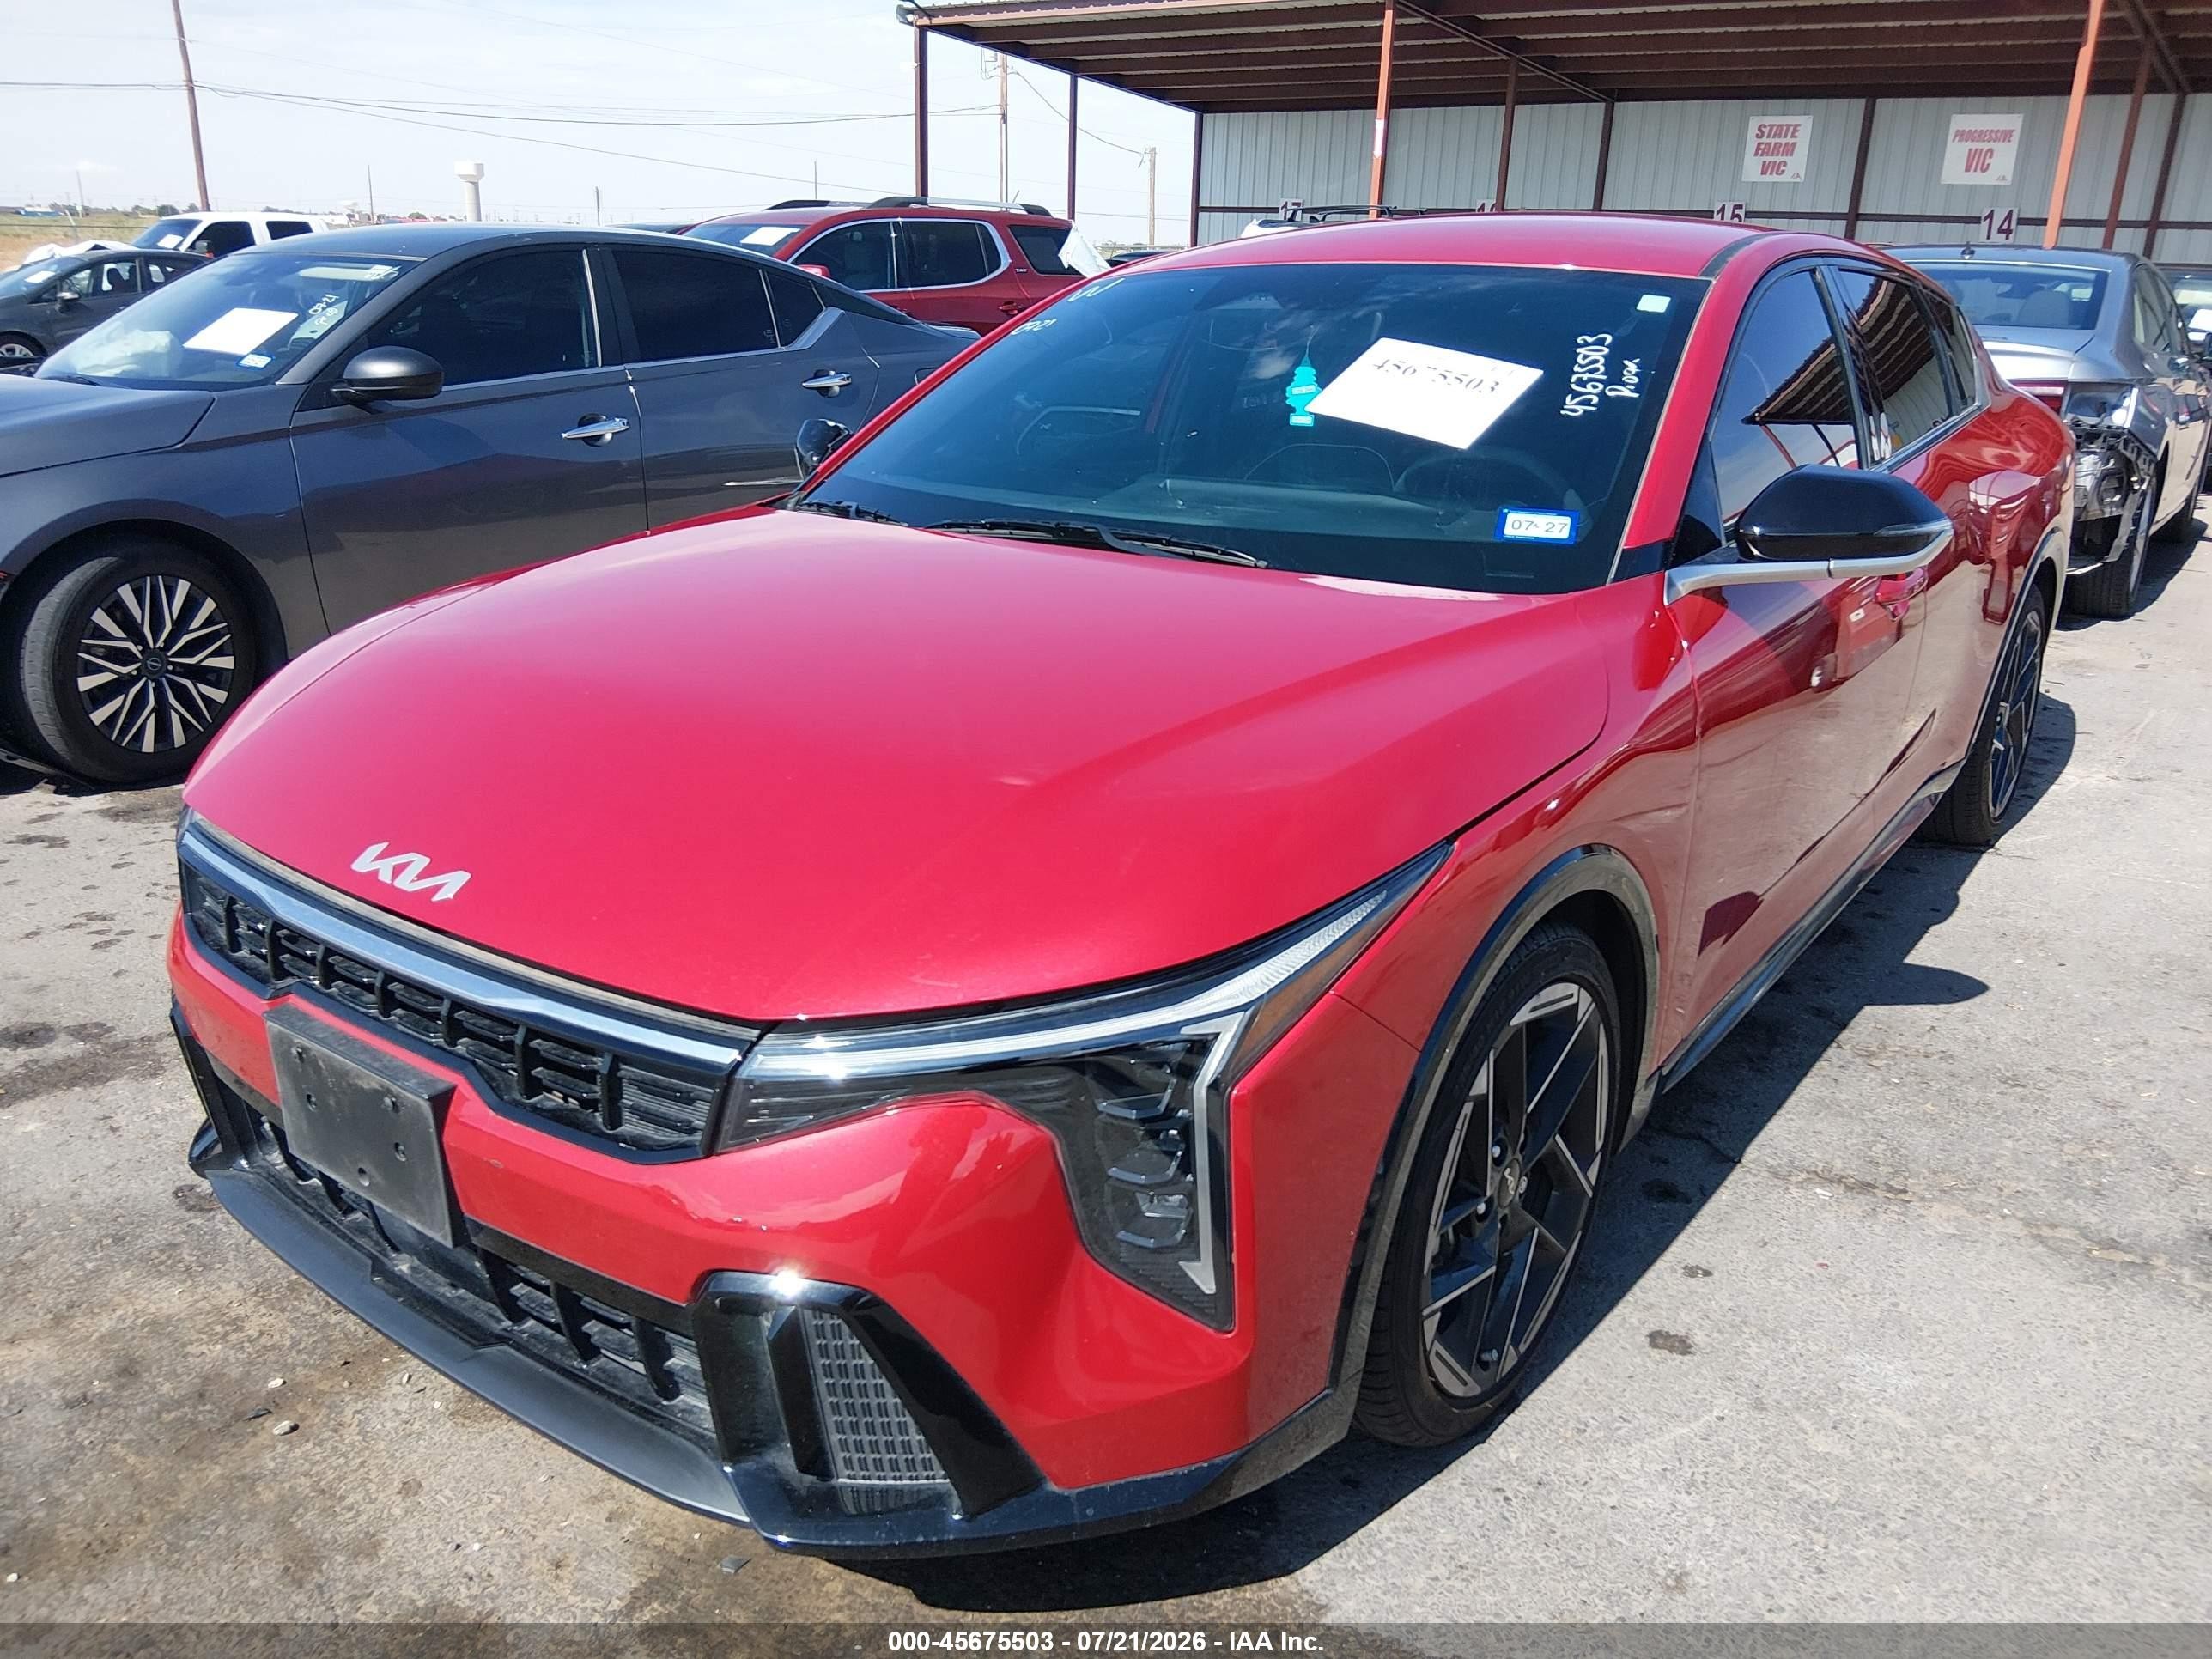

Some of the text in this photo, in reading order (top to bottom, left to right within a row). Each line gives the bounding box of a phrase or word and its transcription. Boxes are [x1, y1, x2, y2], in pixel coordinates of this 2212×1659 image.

[1755, 123, 1802, 139] STATE
[1952, 129, 2015, 143] PROGRESSIVE
[1753, 142, 1797, 157] FARM
[1760, 160, 1788, 176] VIC
[1964, 148, 1994, 173] VIC
[1716, 203, 1743, 222] 15
[1983, 209, 2014, 240] 14
[1559, 333, 1613, 416] 45675503
[350, 842, 472, 902] KIA
